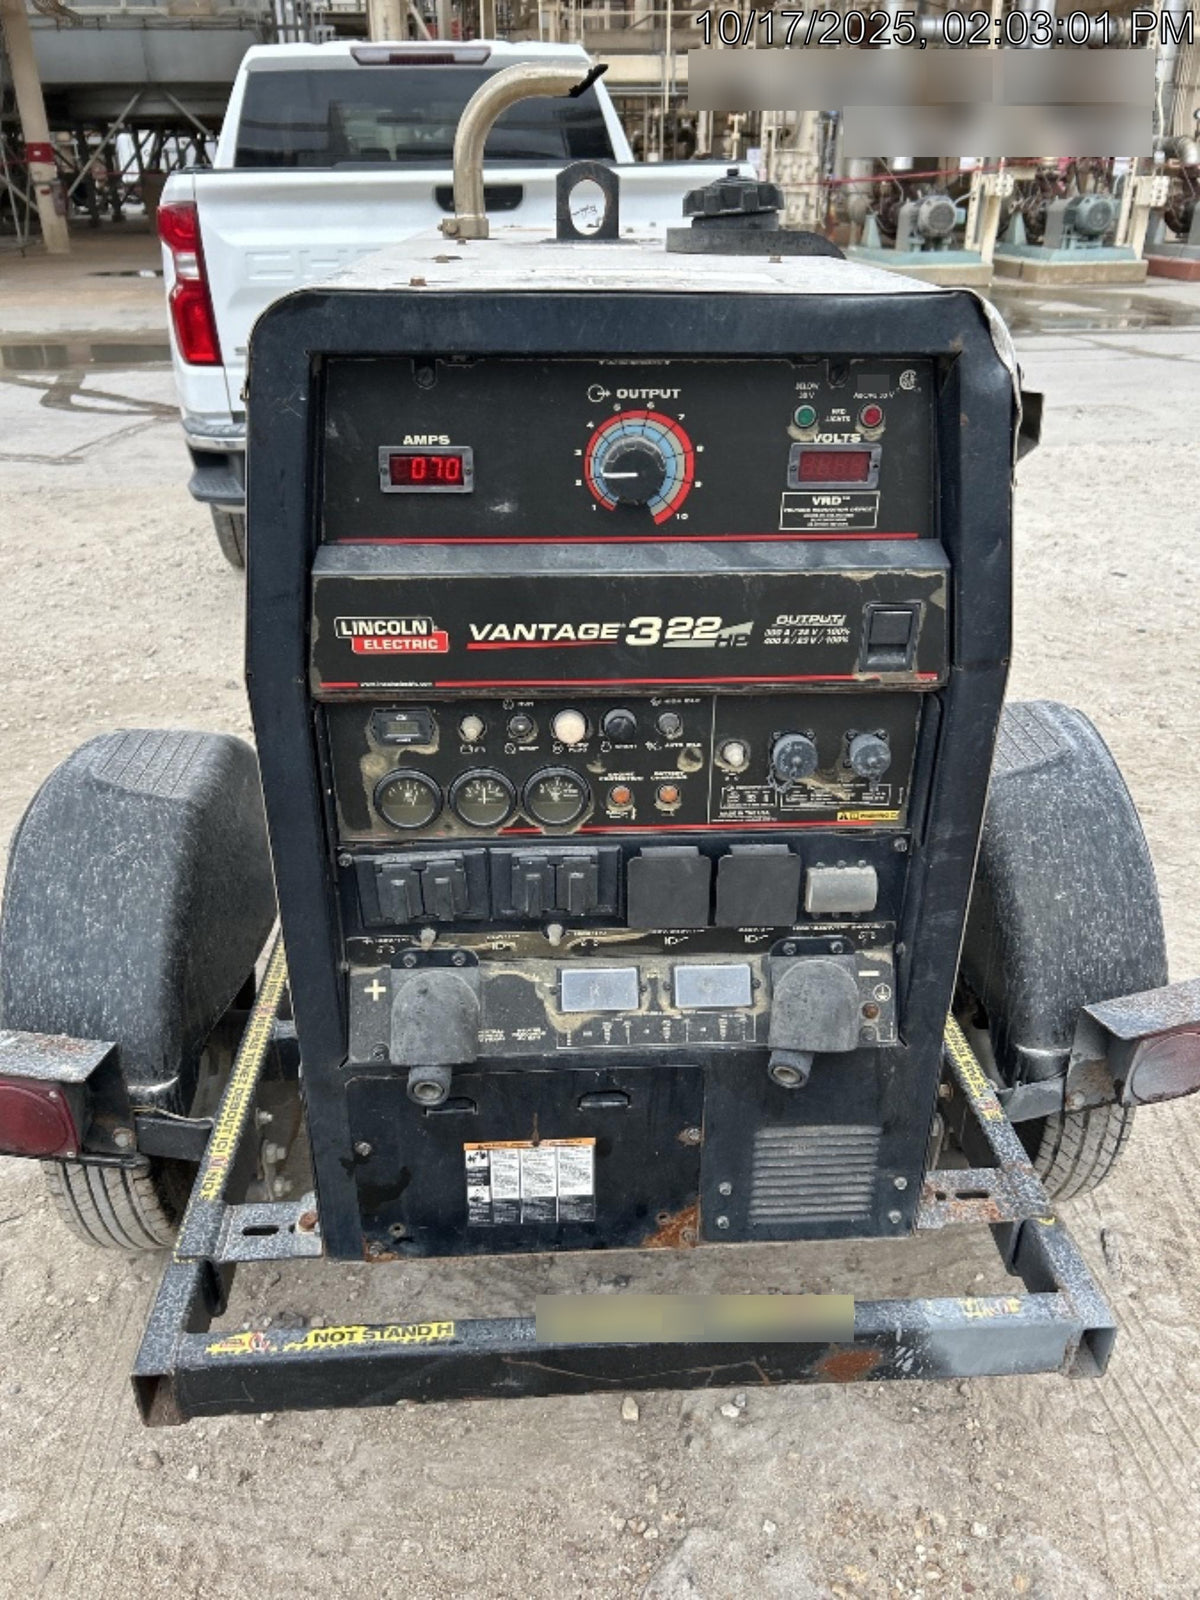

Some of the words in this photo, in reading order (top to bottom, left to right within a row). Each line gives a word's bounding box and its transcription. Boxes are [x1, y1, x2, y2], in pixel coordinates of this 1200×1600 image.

[616, 388, 681, 399] OUTPUT
[403, 435, 450, 445] AMPS
[814, 433, 861, 443] VOLTS
[411, 457, 460, 480] 070
[776, 614, 842, 625] OUTPUT
[340, 620, 428, 636] LINCOLN
[468, 622, 621, 641] VANTAGE
[625, 616, 722, 646] 322
[363, 638, 439, 650] ELECTRIC
[220, 1086, 244, 1134] DEBOUT
[314, 1331, 356, 1343] NOT
[362, 1325, 433, 1339] STAND
